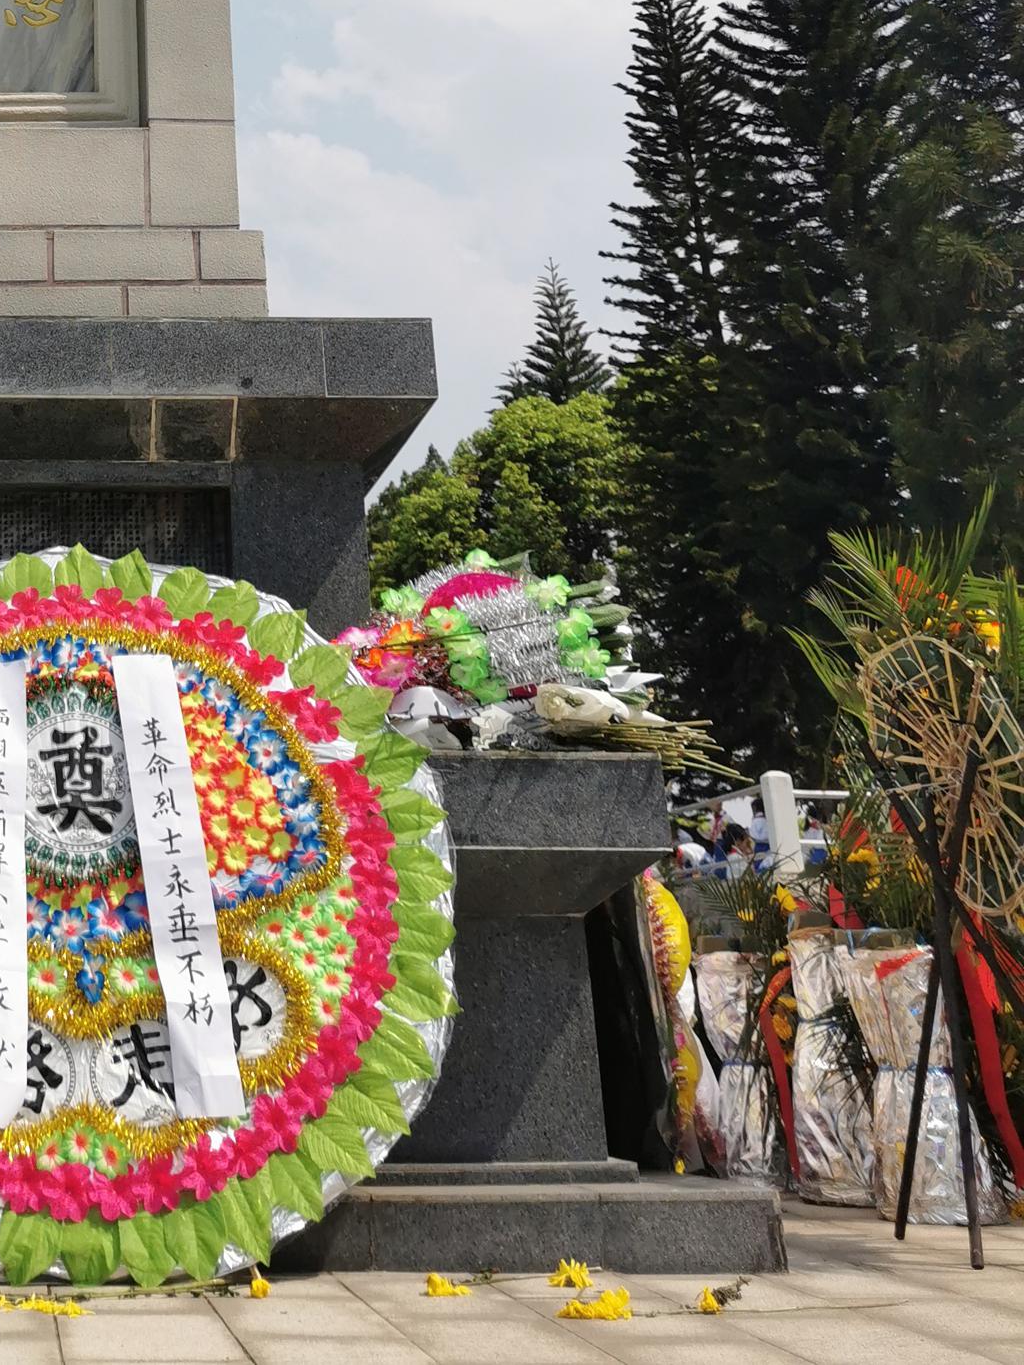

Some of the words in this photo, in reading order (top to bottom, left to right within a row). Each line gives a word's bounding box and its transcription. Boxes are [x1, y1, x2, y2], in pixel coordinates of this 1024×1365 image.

[36, 725, 123, 834] 奠
[140, 717, 214, 1026] 革命烈士永垂不朽
